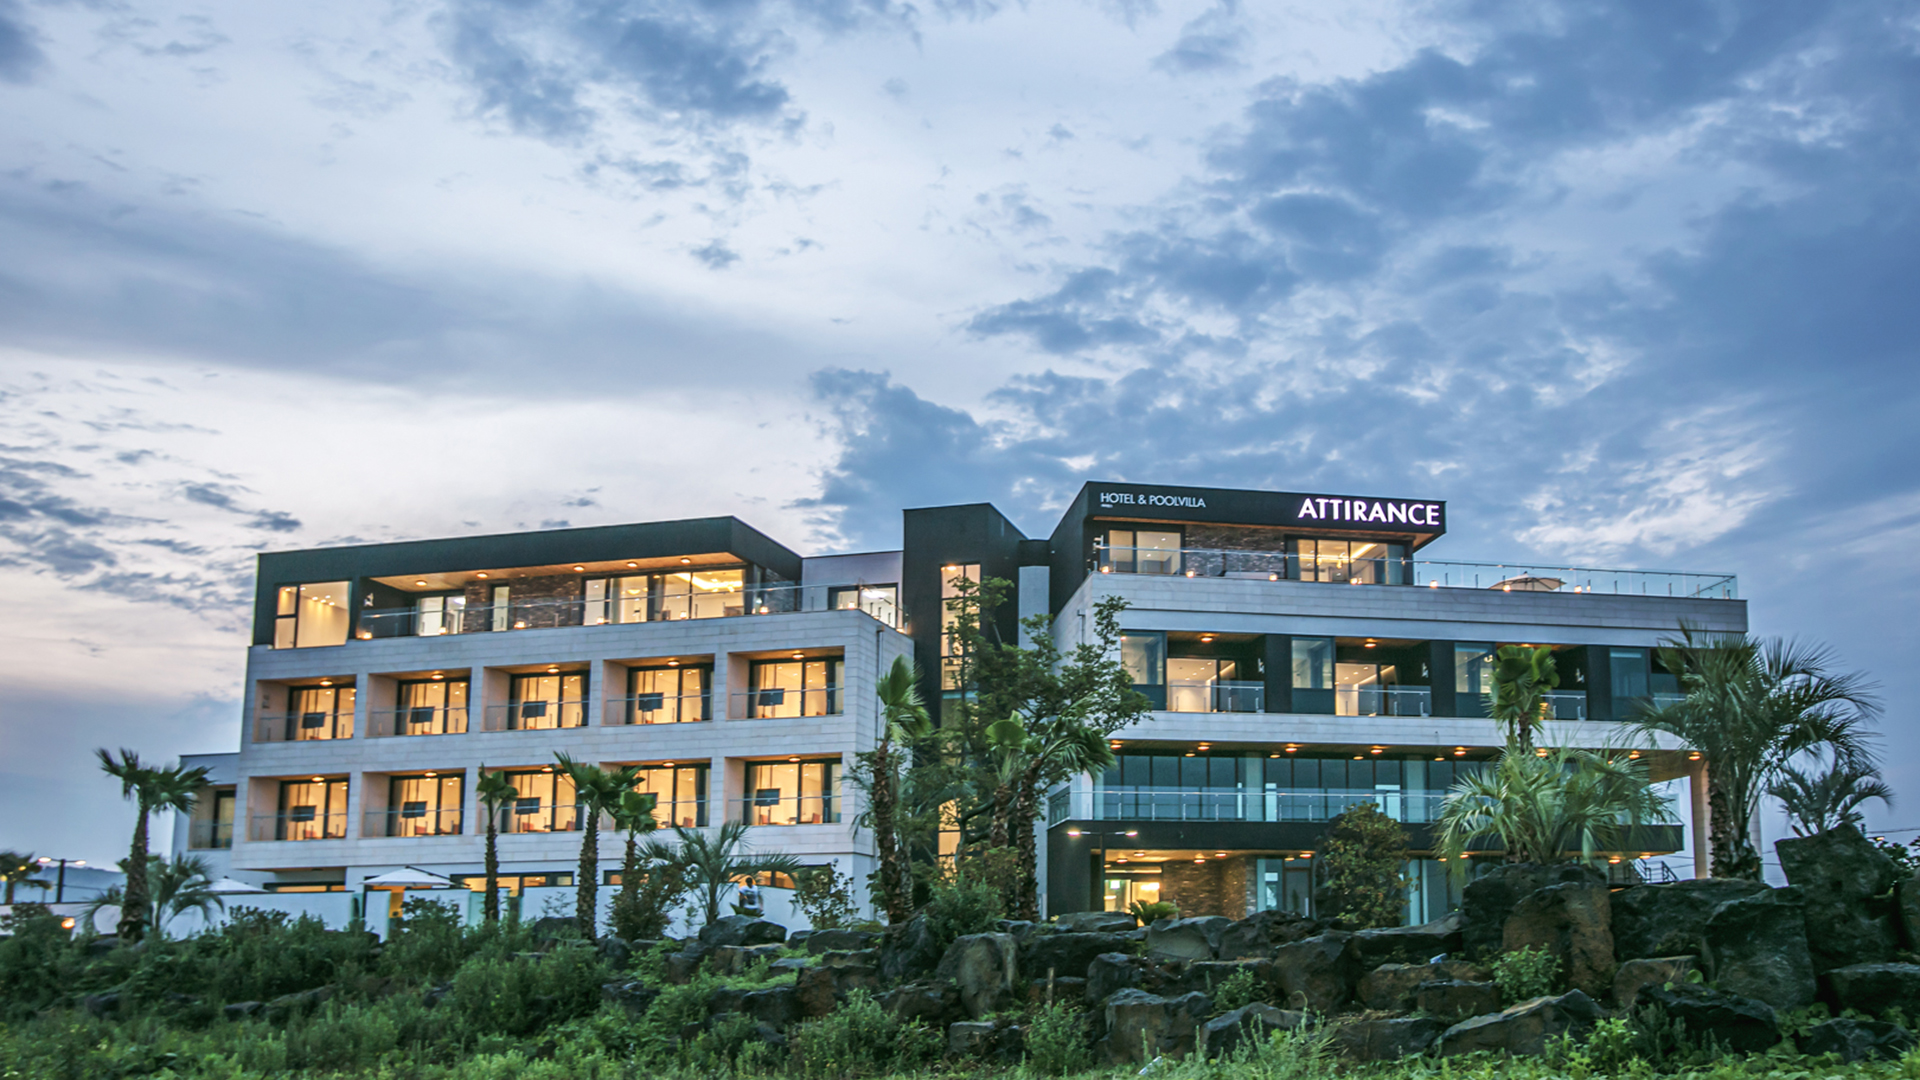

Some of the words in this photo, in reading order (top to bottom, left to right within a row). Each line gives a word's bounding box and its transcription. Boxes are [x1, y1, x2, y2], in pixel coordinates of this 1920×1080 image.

[1100, 492, 1135, 504] HOTEL
[1138, 494, 1147, 505] &
[1149, 495, 1206, 508] POOLVILLA
[1297, 497, 1440, 526] ATTIRANCE
